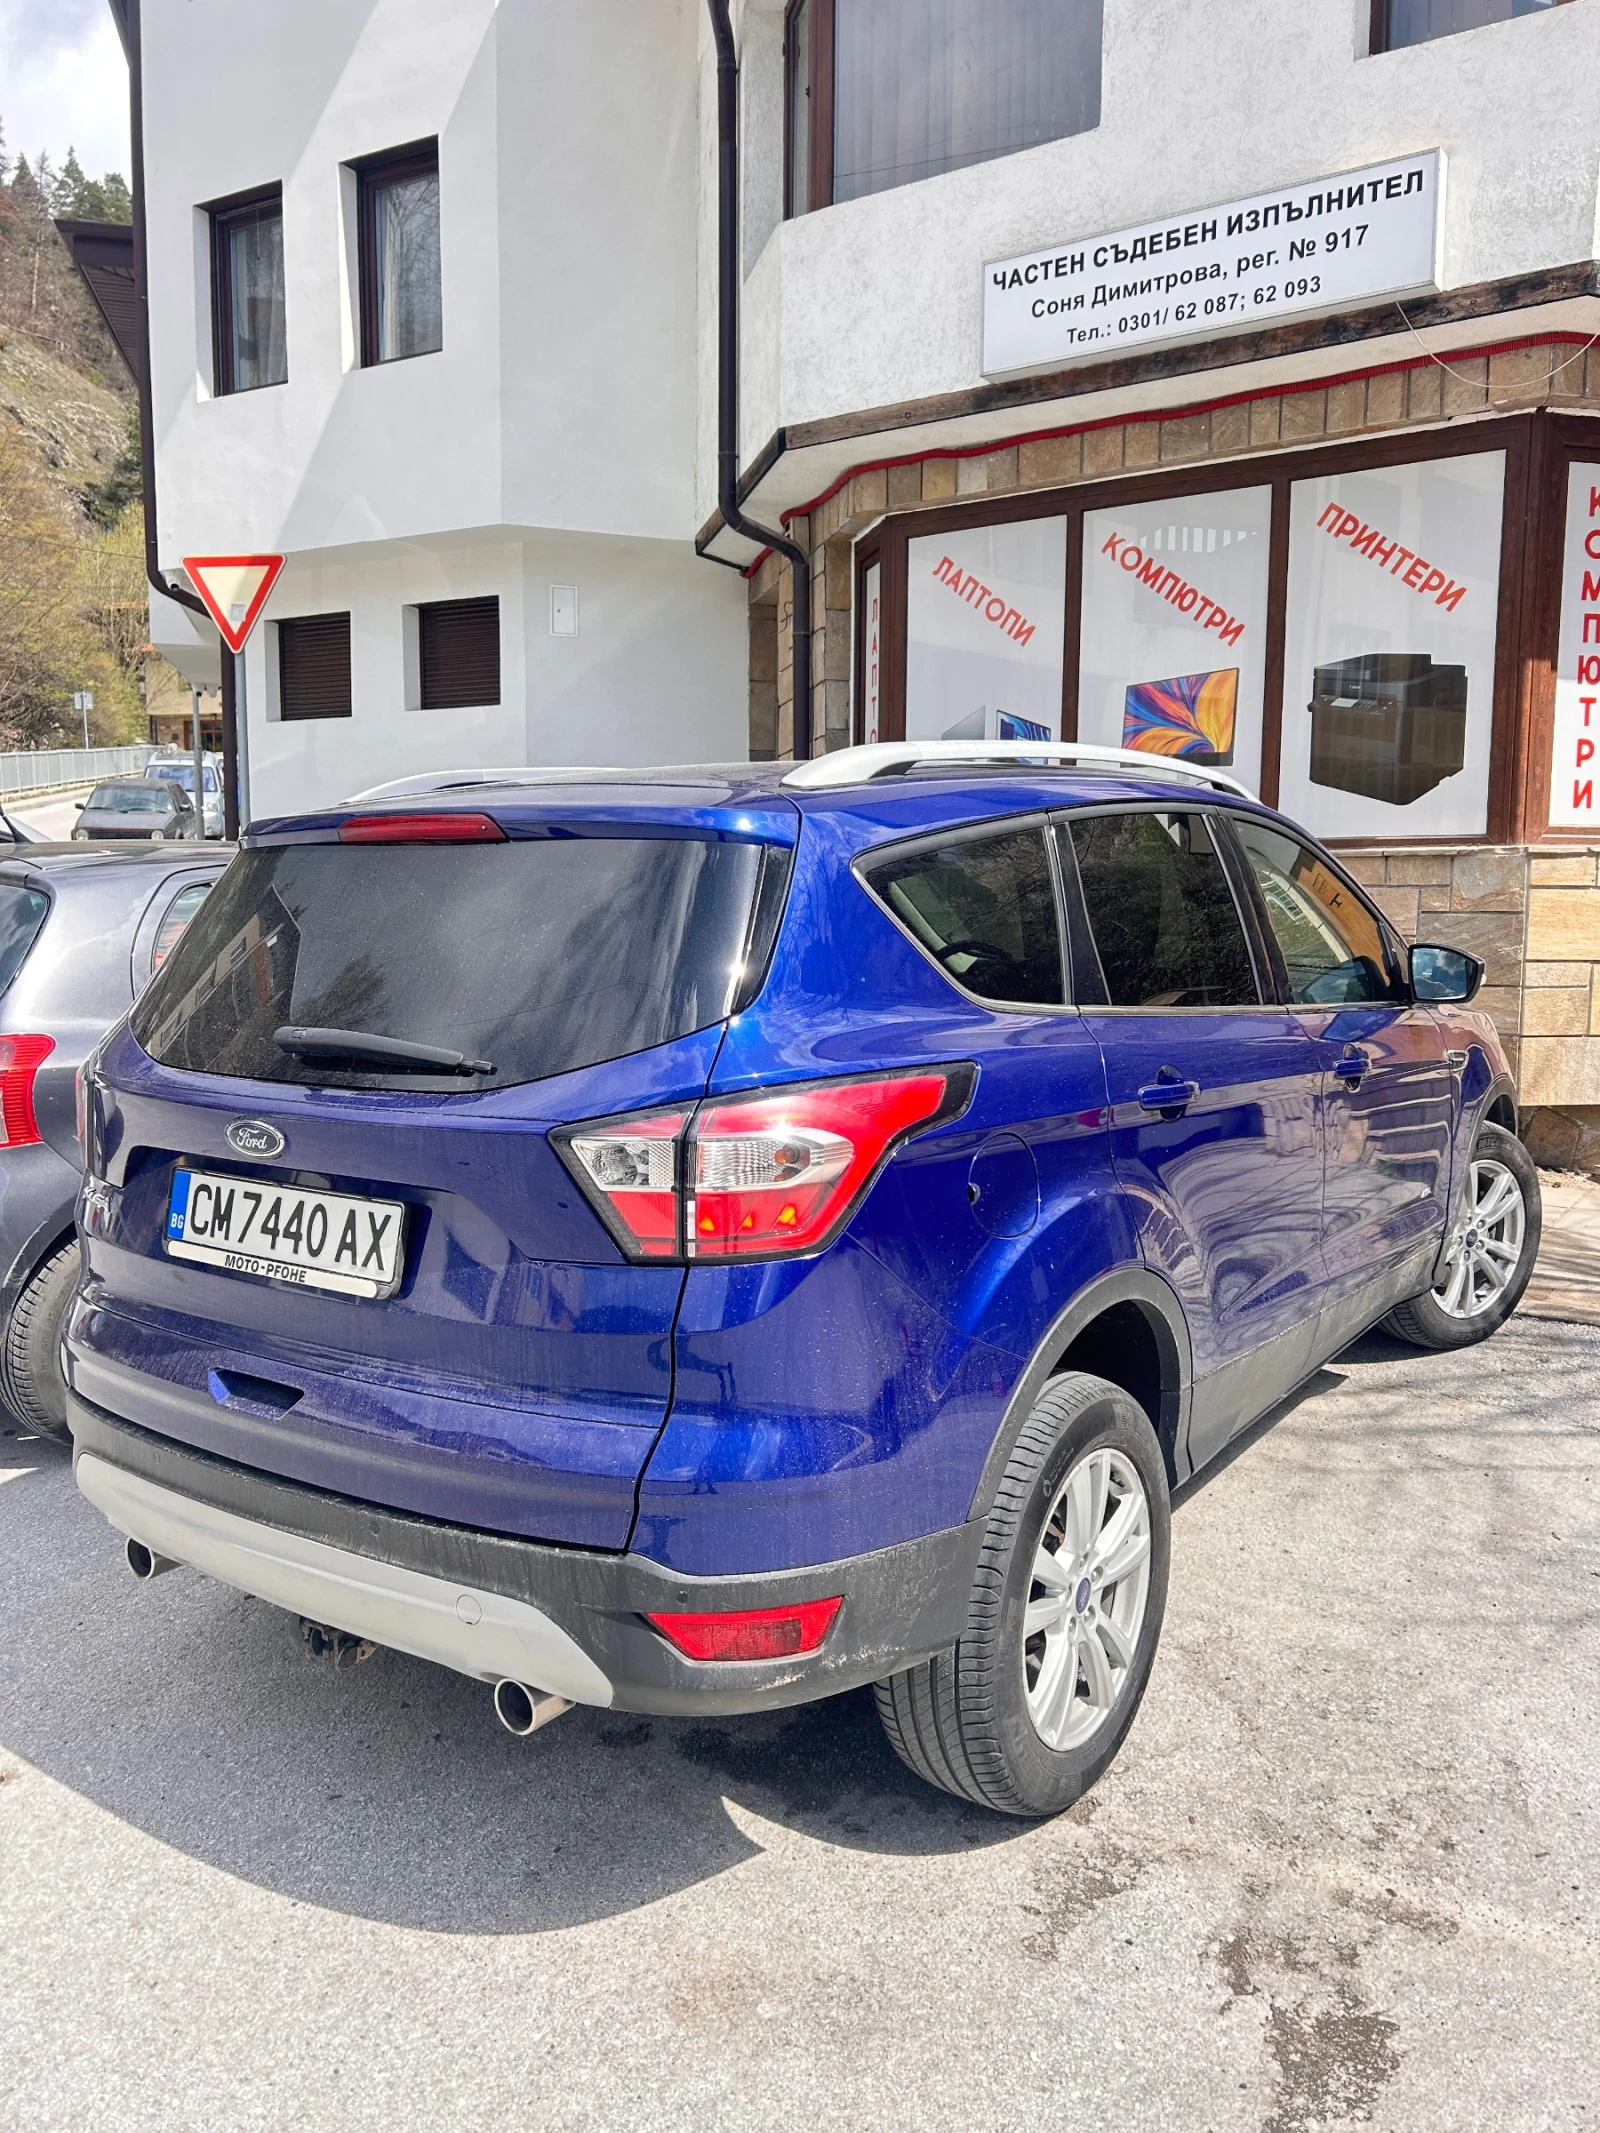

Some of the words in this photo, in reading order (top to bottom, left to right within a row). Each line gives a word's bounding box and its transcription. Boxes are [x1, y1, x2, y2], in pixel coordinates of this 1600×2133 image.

[993, 252, 1085, 291] ЧАСТЕН
[1093, 219, 1218, 267] СЪДЕБЕН
[1226, 169, 1424, 237] ИЗПЪЛНИТЕЛ
[1031, 294, 1085, 318] Соня
[1091, 263, 1229, 309] Димитрова,
[1236, 249, 1280, 277] рег.
[1289, 238, 1317, 262] №
[1325, 224, 1369, 253] 917
[1067, 323, 1112, 344] Тел.:
[1118, 307, 1169, 333] 0301/
[1175, 302, 1197, 321] 62
[1204, 292, 1247, 316] 087;
[1253, 285, 1277, 304] 62
[1284, 275, 1322, 299] 093
[932, 556, 1036, 647] ЛАПТОПИ
[1101, 532, 1245, 647] КОМПЮТРИ
[1316, 502, 1467, 613] ПРИНТЕРИ
[236, 1128, 268, 1150] Ford
[171, 1213, 184, 1229] BG
[224, 1254, 307, 1283] MOTO-PFOHE
